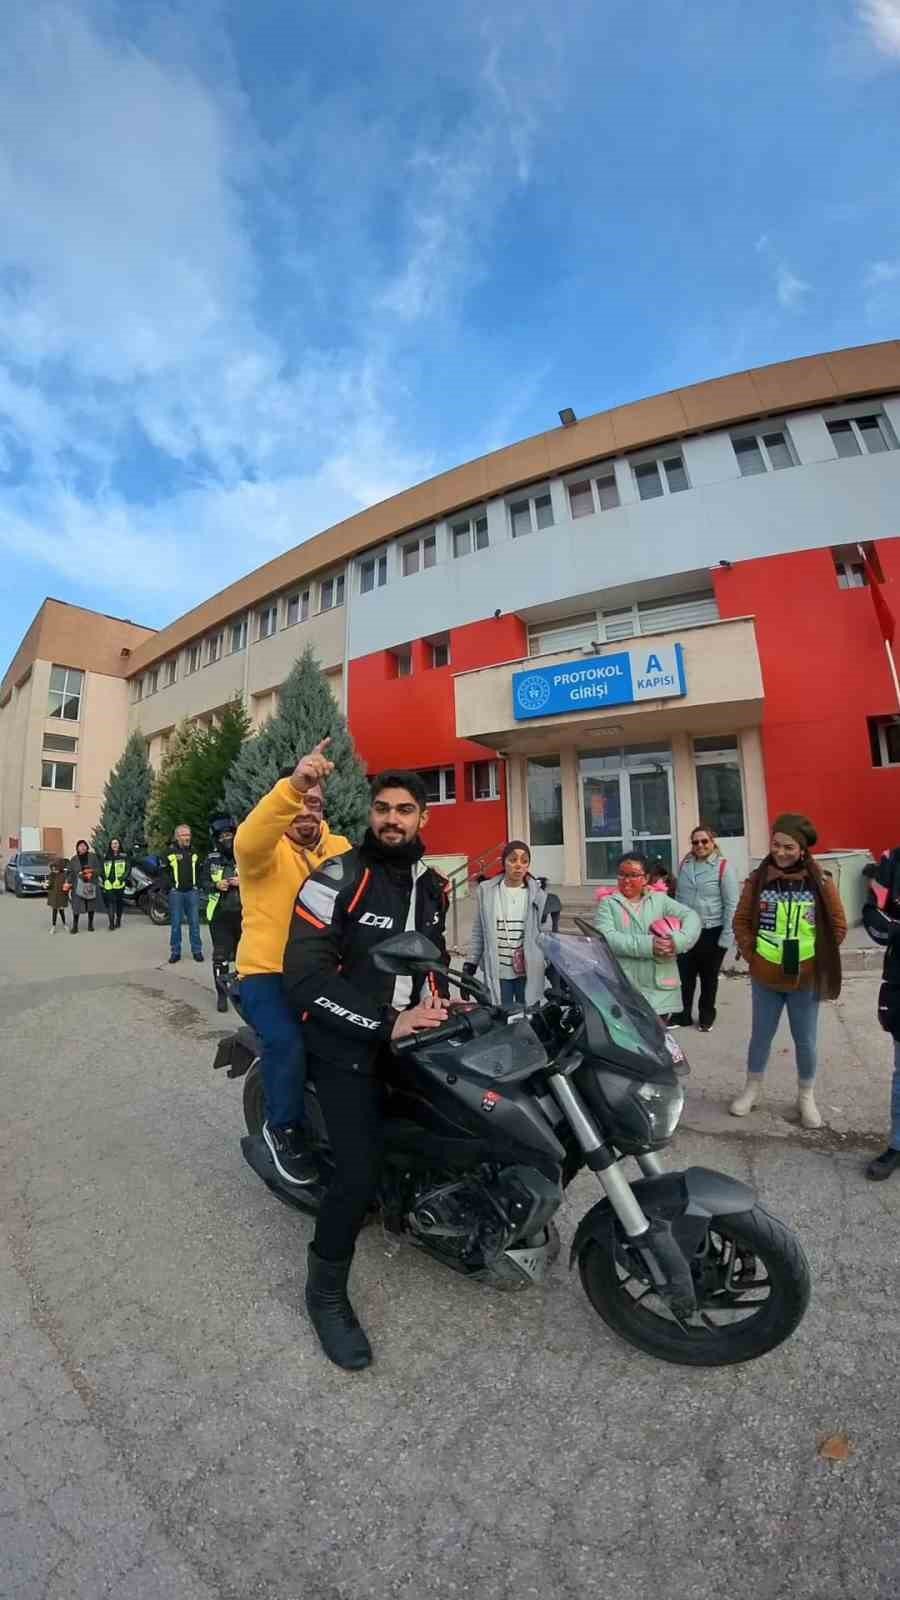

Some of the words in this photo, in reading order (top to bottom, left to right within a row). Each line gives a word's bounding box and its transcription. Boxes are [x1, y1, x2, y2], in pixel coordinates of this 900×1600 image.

[646, 654, 662, 674] A
[553, 664, 624, 687] PROTOKOL
[637, 675, 674, 689] KAPISI
[570, 681, 608, 700] GİRİŞİ
[314, 996, 382, 1030] DAINESE
